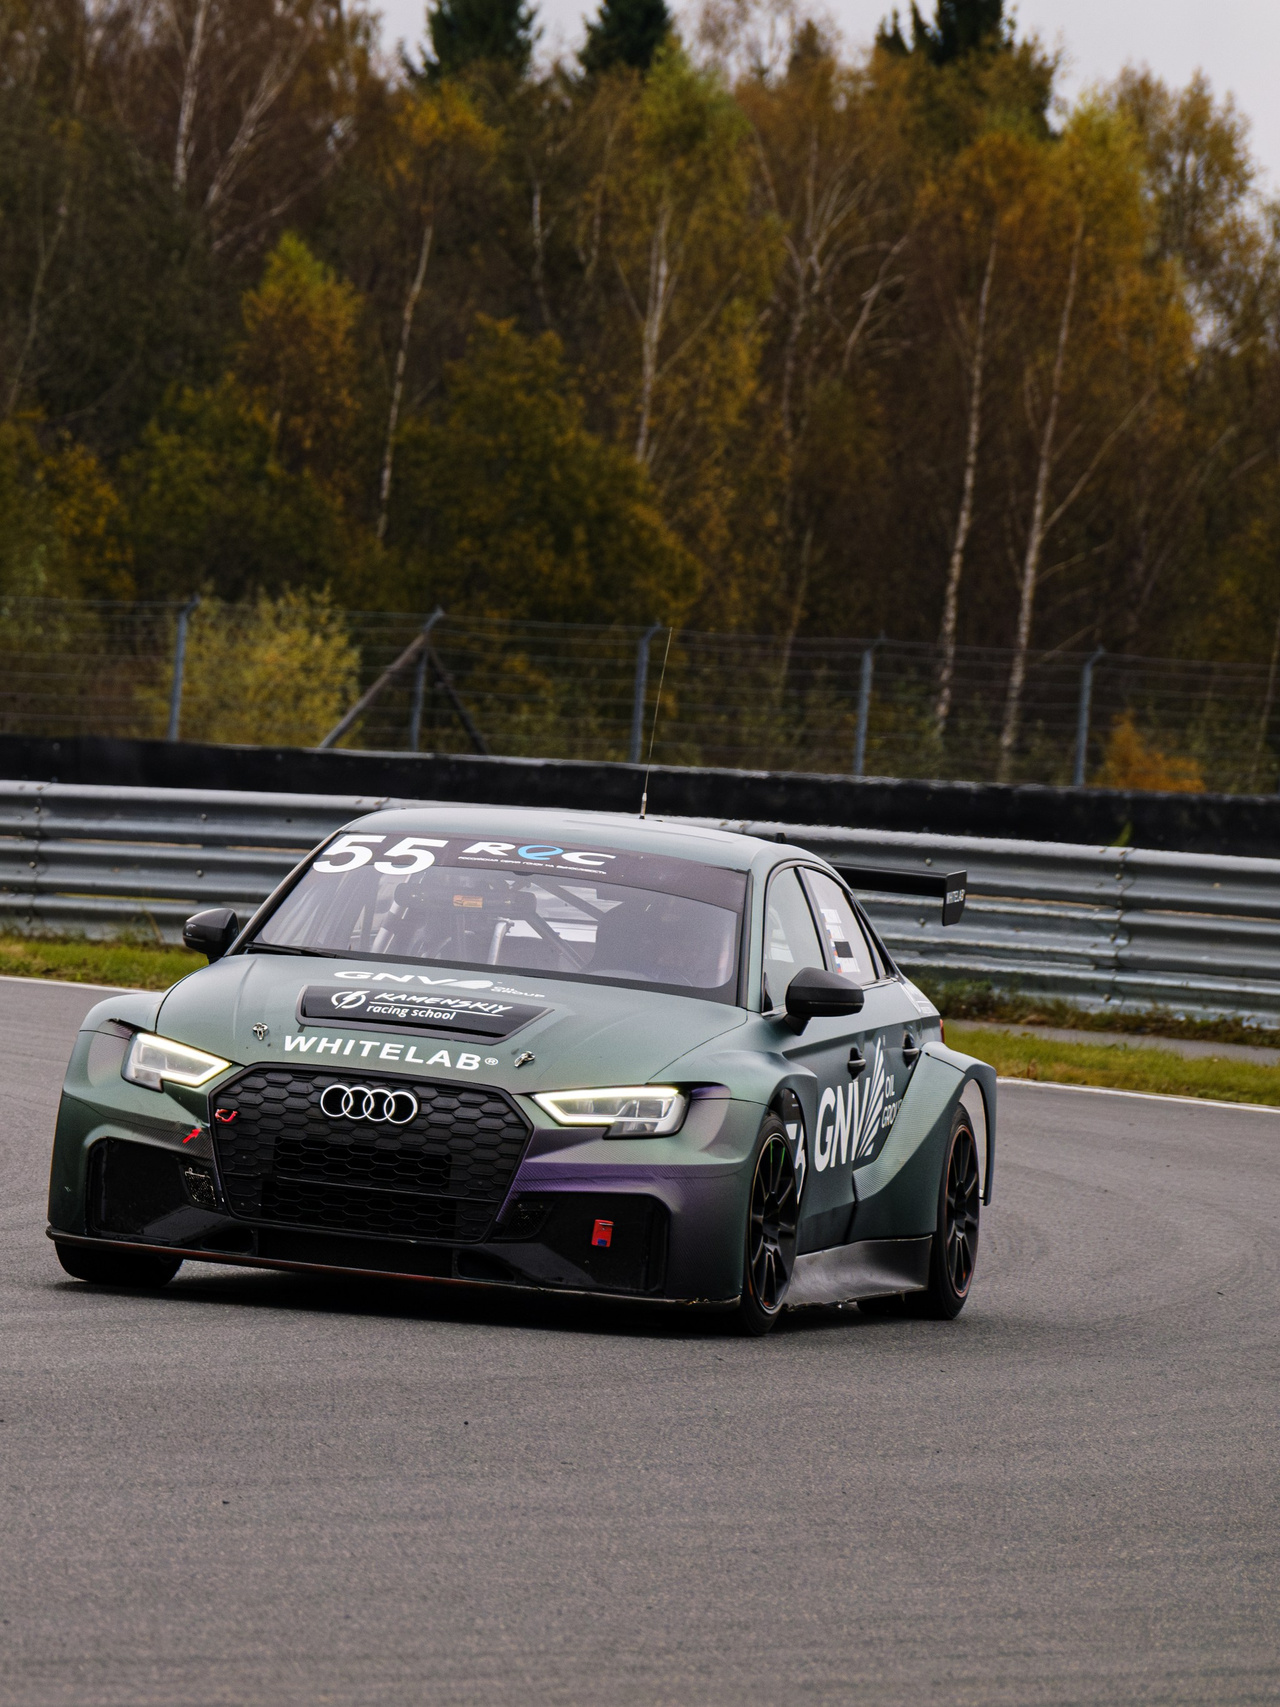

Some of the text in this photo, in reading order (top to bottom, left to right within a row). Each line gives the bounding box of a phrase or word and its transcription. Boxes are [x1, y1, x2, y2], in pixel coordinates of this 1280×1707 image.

[313, 835, 449, 875] 55
[333, 971, 460, 986] GNV
[366, 1005, 457, 1021] racing school
[373, 992, 514, 1014] KAMENSKIY
[885, 1074, 896, 1099] OIL
[814, 1077, 871, 1173] GNV
